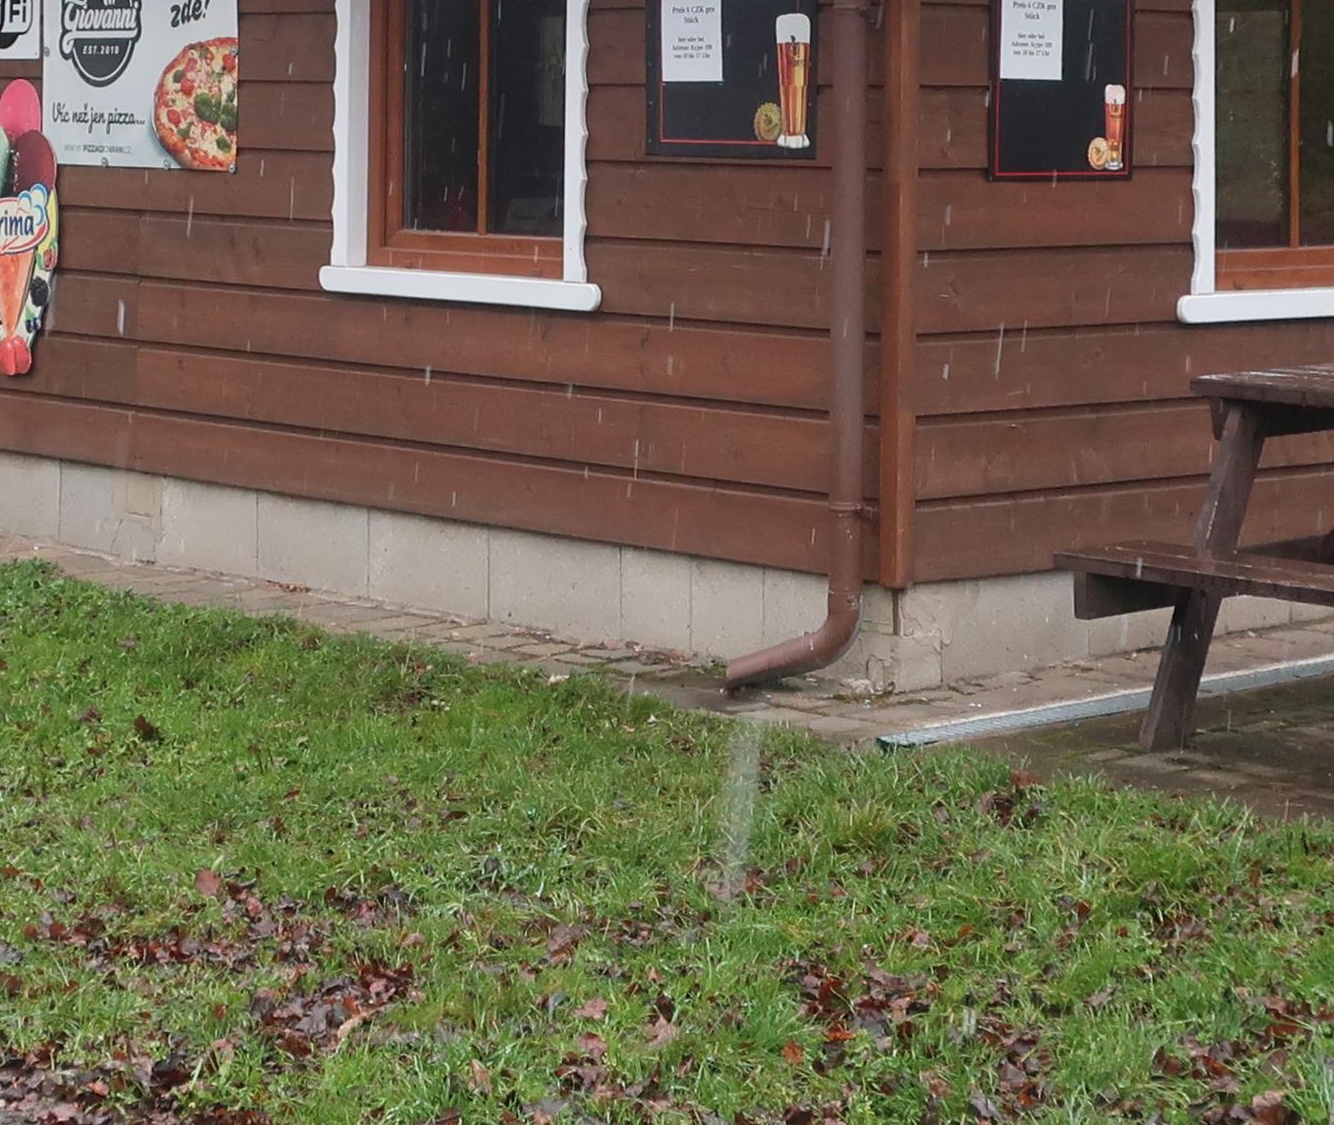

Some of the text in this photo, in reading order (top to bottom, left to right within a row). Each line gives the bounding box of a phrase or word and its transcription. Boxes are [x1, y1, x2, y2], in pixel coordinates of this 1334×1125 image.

[52, 102, 71, 124] Víc
[72, 102, 90, 124] než
[88, 109, 105, 134] jen
